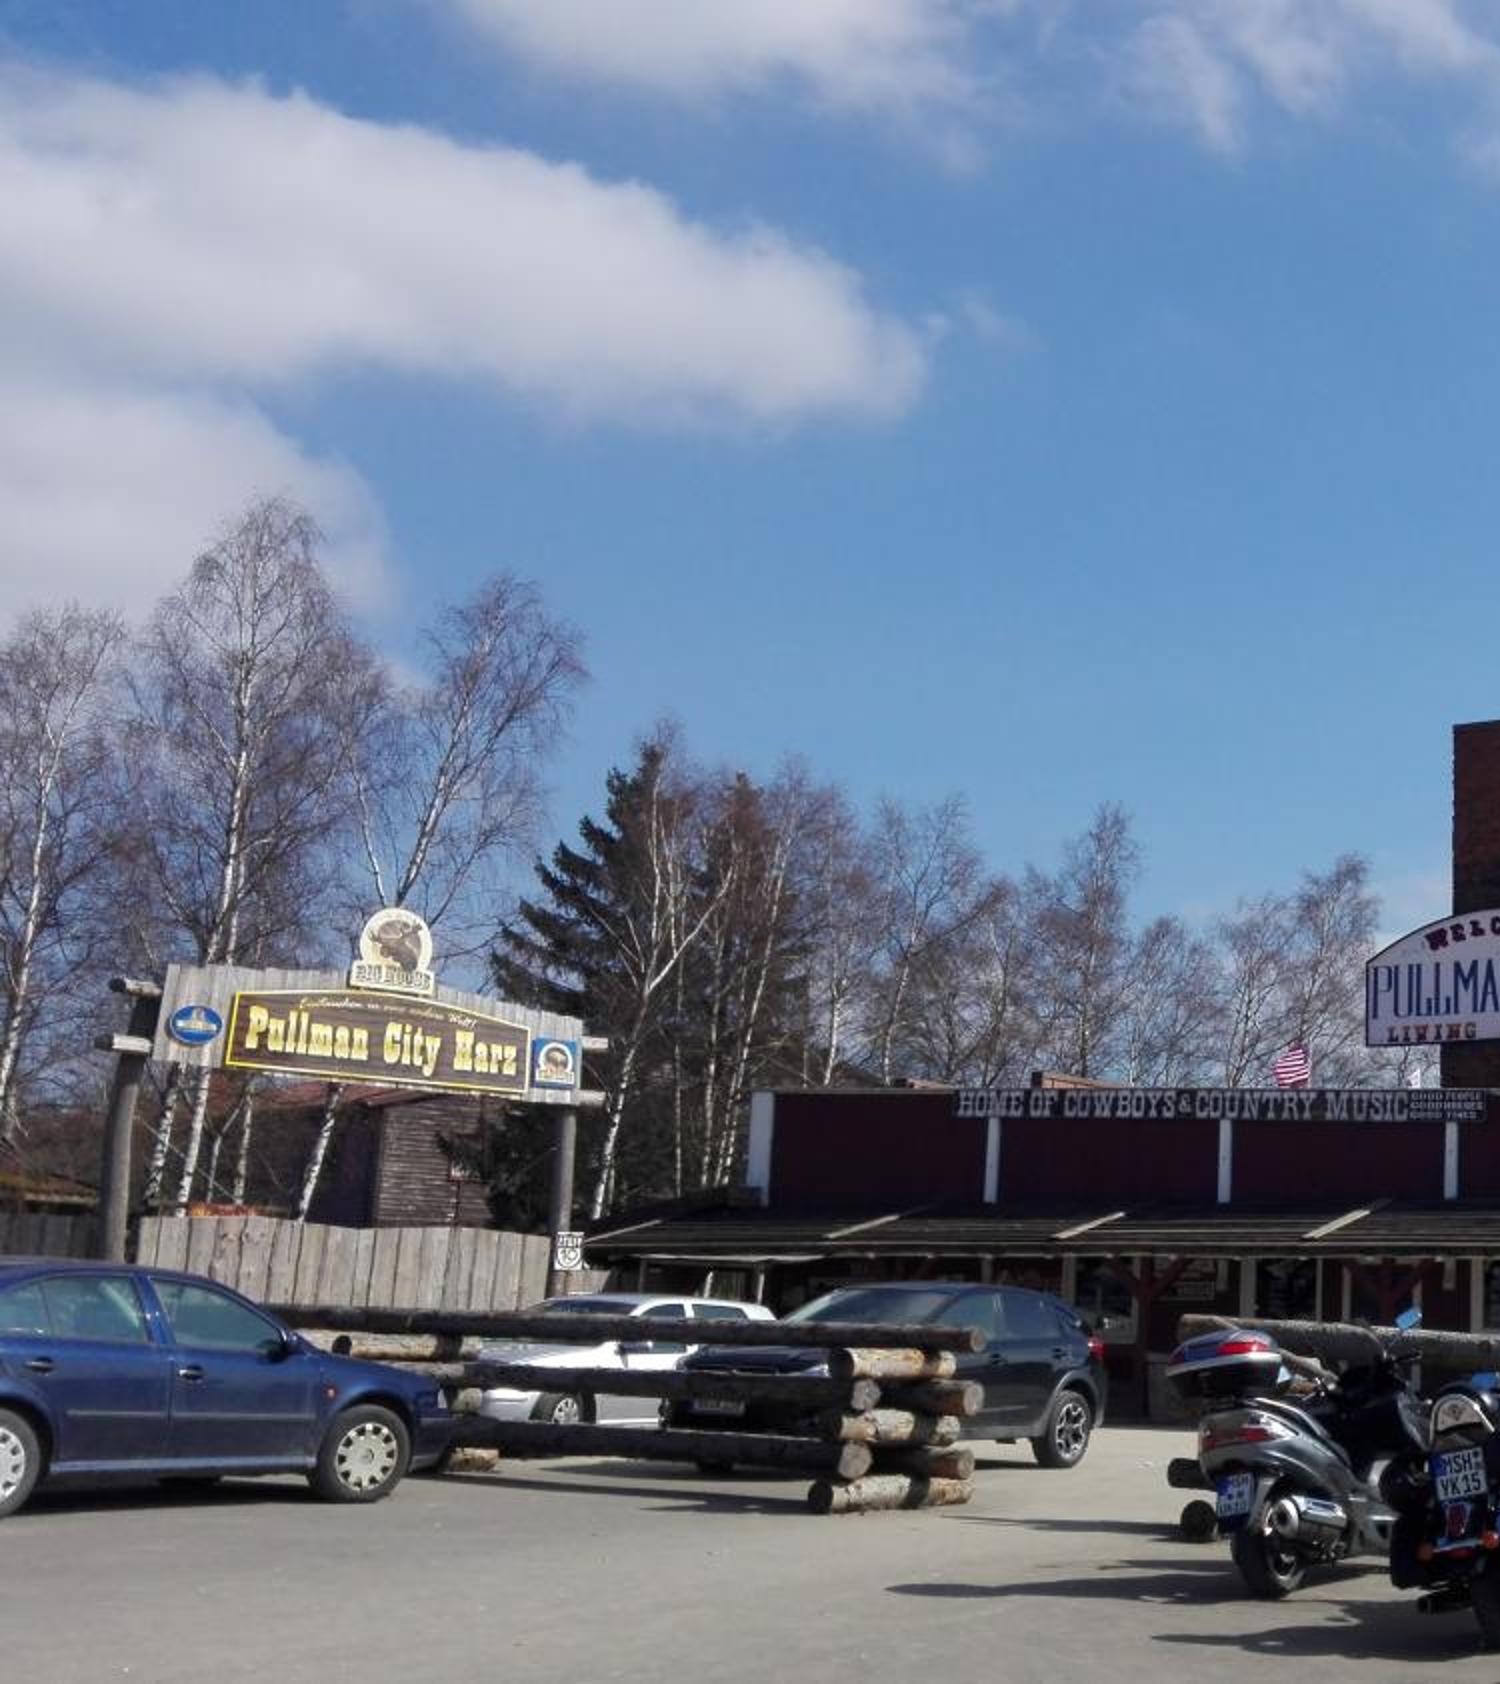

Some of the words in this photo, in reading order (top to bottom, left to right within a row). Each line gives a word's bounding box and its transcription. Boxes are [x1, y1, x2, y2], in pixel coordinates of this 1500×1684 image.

[245, 1005, 369, 1061] Pullman
[383, 1021, 442, 1077] City
[453, 1030, 518, 1076] Harz
[1387, 1022, 1477, 1042] LIVING
[957, 1090, 1024, 1117] HOME
[1029, 1090, 1059, 1117] OF
[1324, 1091, 1408, 1121] MUSIC
